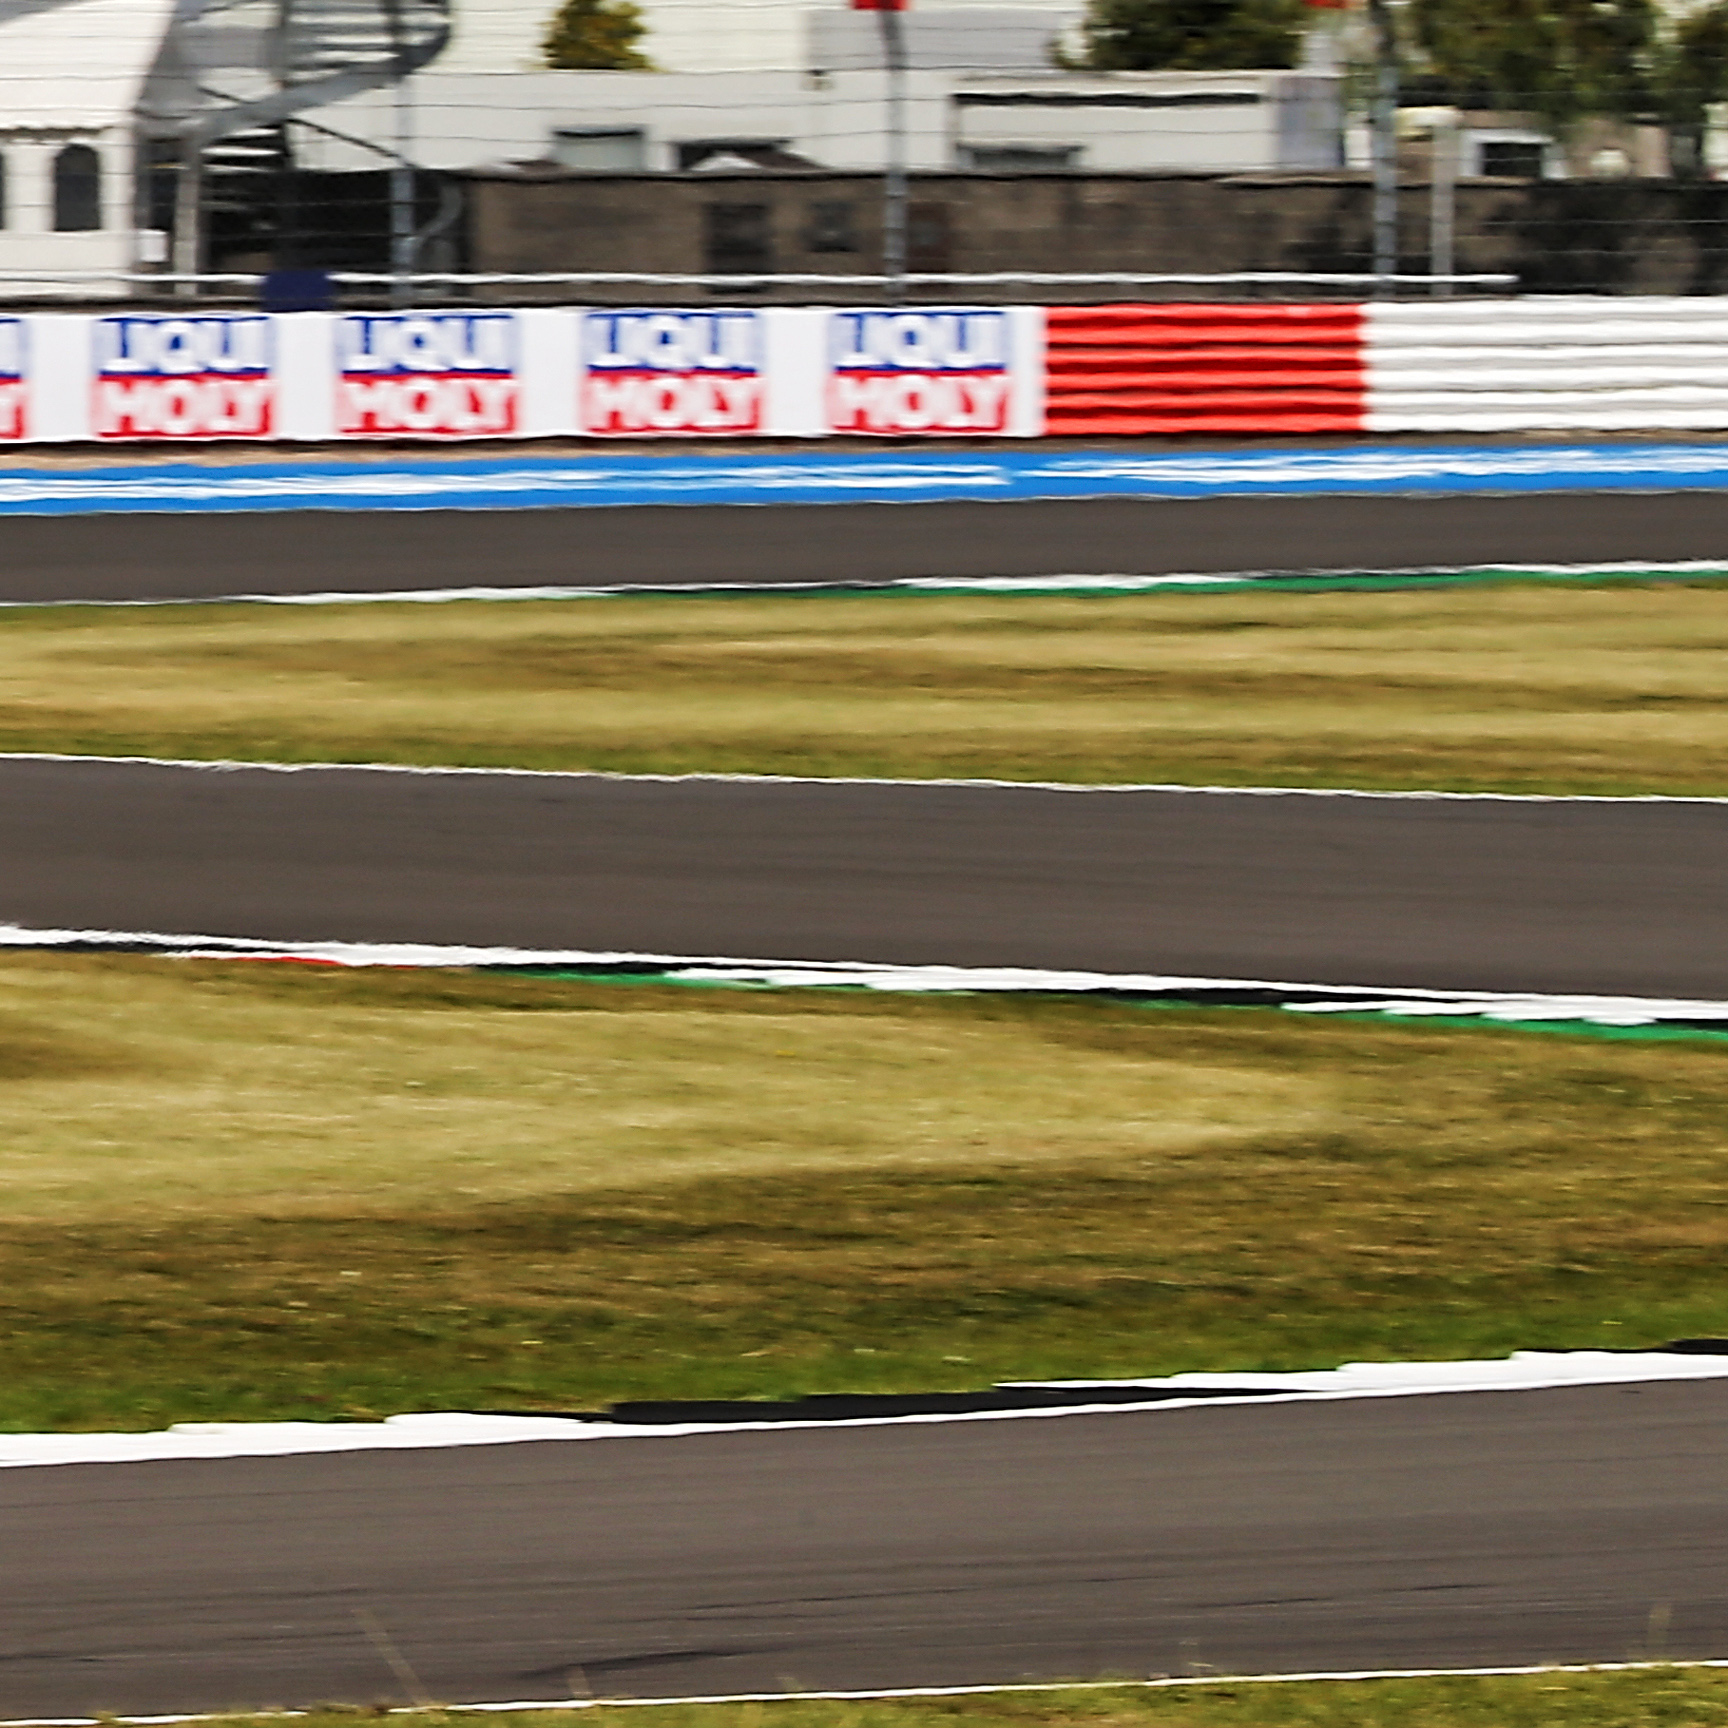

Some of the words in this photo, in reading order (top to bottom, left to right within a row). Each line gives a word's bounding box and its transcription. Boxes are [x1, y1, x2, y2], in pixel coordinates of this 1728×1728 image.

[96, 321, 273, 373] LIQUI
[339, 319, 516, 371] LIQUI
[585, 315, 761, 369] LIQUI
[830, 313, 1011, 367] LIQUI
[96, 381, 273, 432] MOLY
[339, 379, 516, 430] MOLY
[585, 377, 761, 429] MOLY
[830, 375, 1011, 427] MOLY
